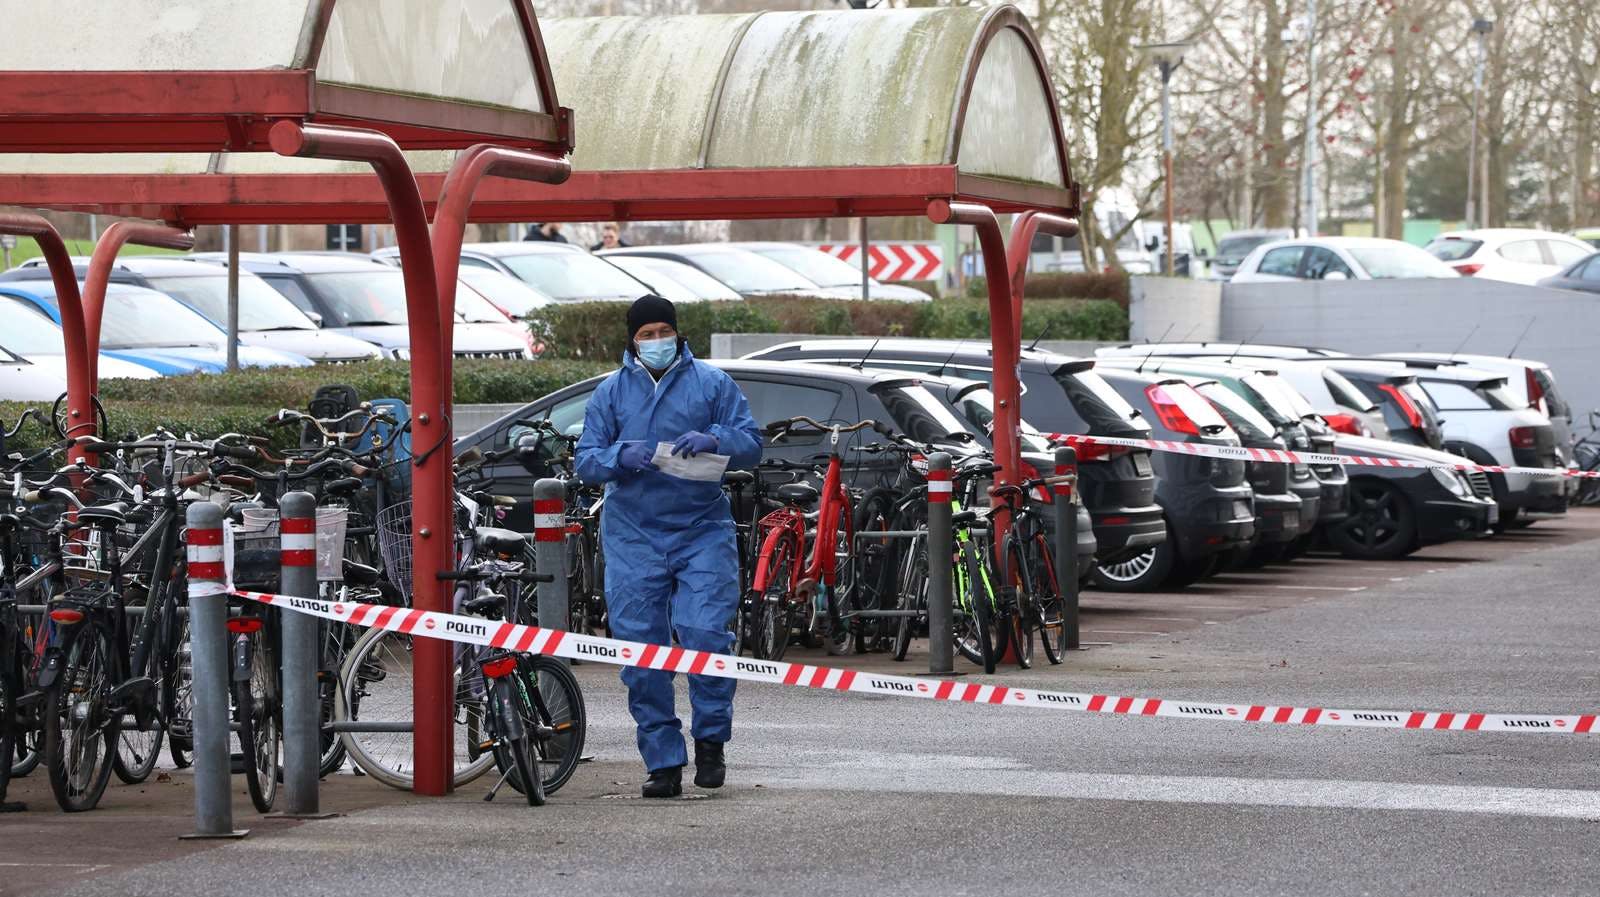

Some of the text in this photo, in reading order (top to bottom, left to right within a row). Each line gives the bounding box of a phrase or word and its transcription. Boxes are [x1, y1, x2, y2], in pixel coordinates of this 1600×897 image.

[289, 597, 329, 613] POLITI
[446, 621, 486, 636] POLITI
[576, 643, 617, 658] POLITI
[736, 661, 778, 675] POLITI
[871, 680, 913, 692] POLITI
[1037, 694, 1080, 704] POLITI
[1178, 706, 1223, 715] POLITI
[1353, 713, 1399, 721] POLITI
[1503, 719, 1551, 728] POLITI
